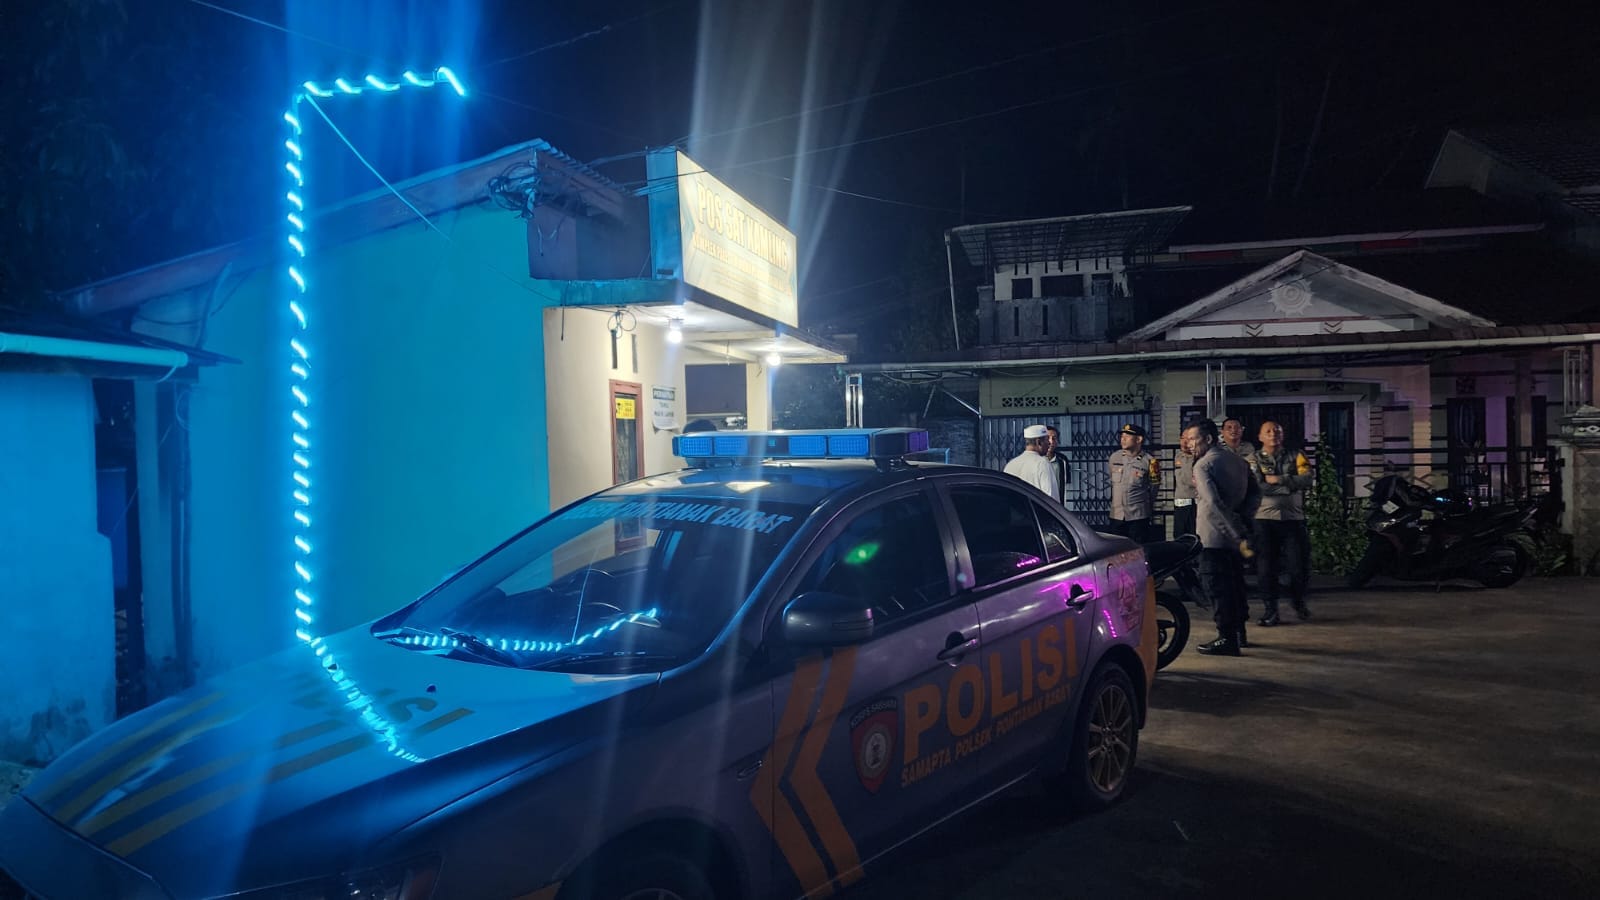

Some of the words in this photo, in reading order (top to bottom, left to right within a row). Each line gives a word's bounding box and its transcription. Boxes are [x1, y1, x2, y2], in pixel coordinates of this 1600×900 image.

[697, 182, 723, 235] POS
[725, 201, 745, 248] SAT
[616, 501, 725, 523] PONTIANAK
[711, 507, 793, 534] BARAT
[904, 618, 1078, 765] POLISI
[901, 749, 951, 788] SAMAPTA
[955, 727, 992, 760] POLSEK
[1045, 684, 1072, 711] BARAT
